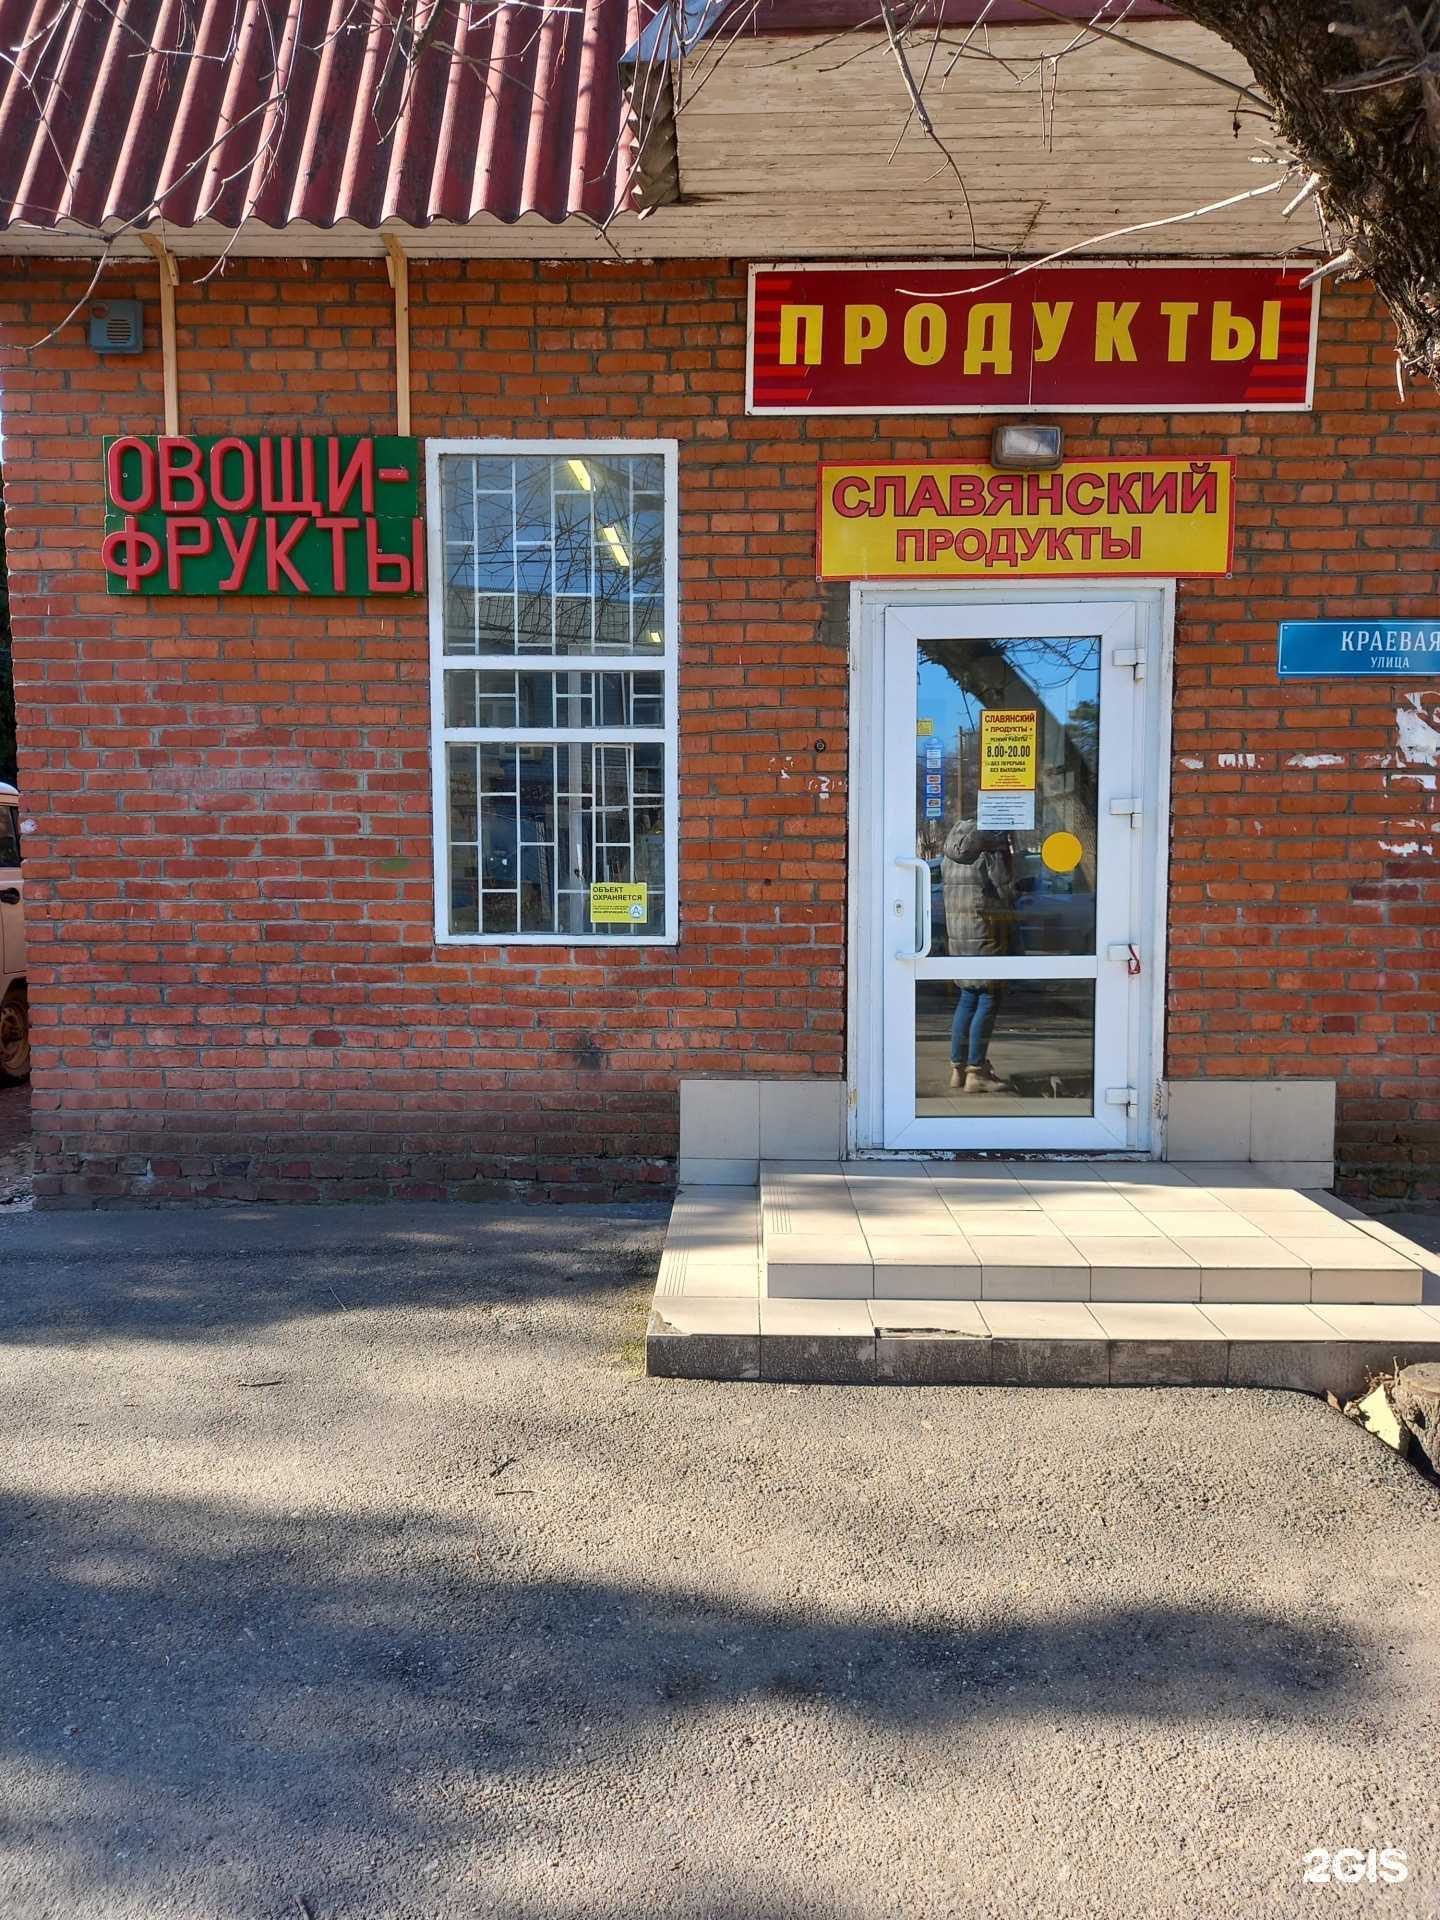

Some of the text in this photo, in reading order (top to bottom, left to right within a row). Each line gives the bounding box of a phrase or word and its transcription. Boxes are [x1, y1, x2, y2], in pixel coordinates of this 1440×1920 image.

[779, 300, 1282, 375] ПРОДУКТЫ
[108, 436, 410, 517] ОВОЩИ-
[832, 462, 1218, 517] СЛАВЯНСКИЙ
[101, 516, 425, 593] ФРУКТЫ
[896, 526, 1142, 567] ПРОДУКТЫ
[1340, 630, 1440, 651] КРАЕВАЯ
[1371, 656, 1410, 669] УЛИЦА
[984, 713, 1035, 723] СЛАВЯНСКИЙ
[987, 745, 1031, 757] 8.00-20.00
